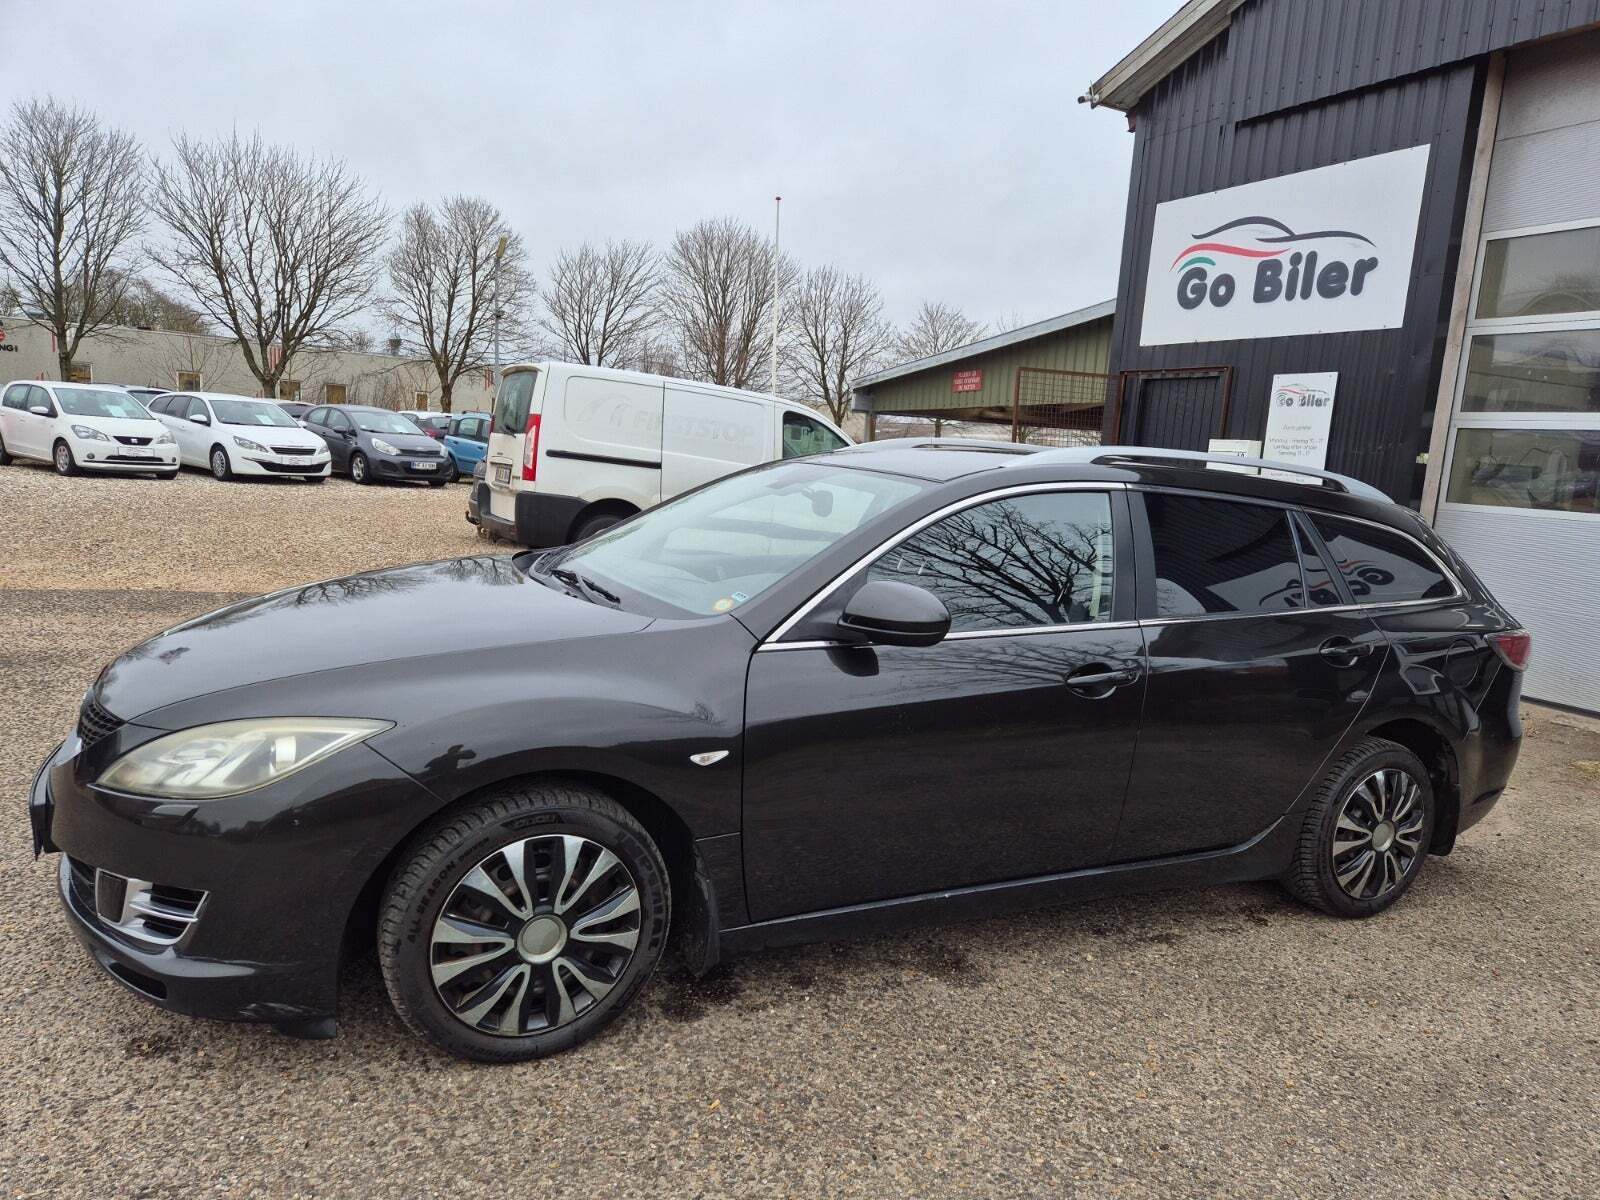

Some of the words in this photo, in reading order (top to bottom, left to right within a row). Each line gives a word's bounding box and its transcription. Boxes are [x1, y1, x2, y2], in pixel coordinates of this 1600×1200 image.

[1176, 266, 1236, 310] Go
[1252, 250, 1379, 304] Biler
[407, 918, 422, 944] ALL
[416, 860, 457, 914] SEASON
